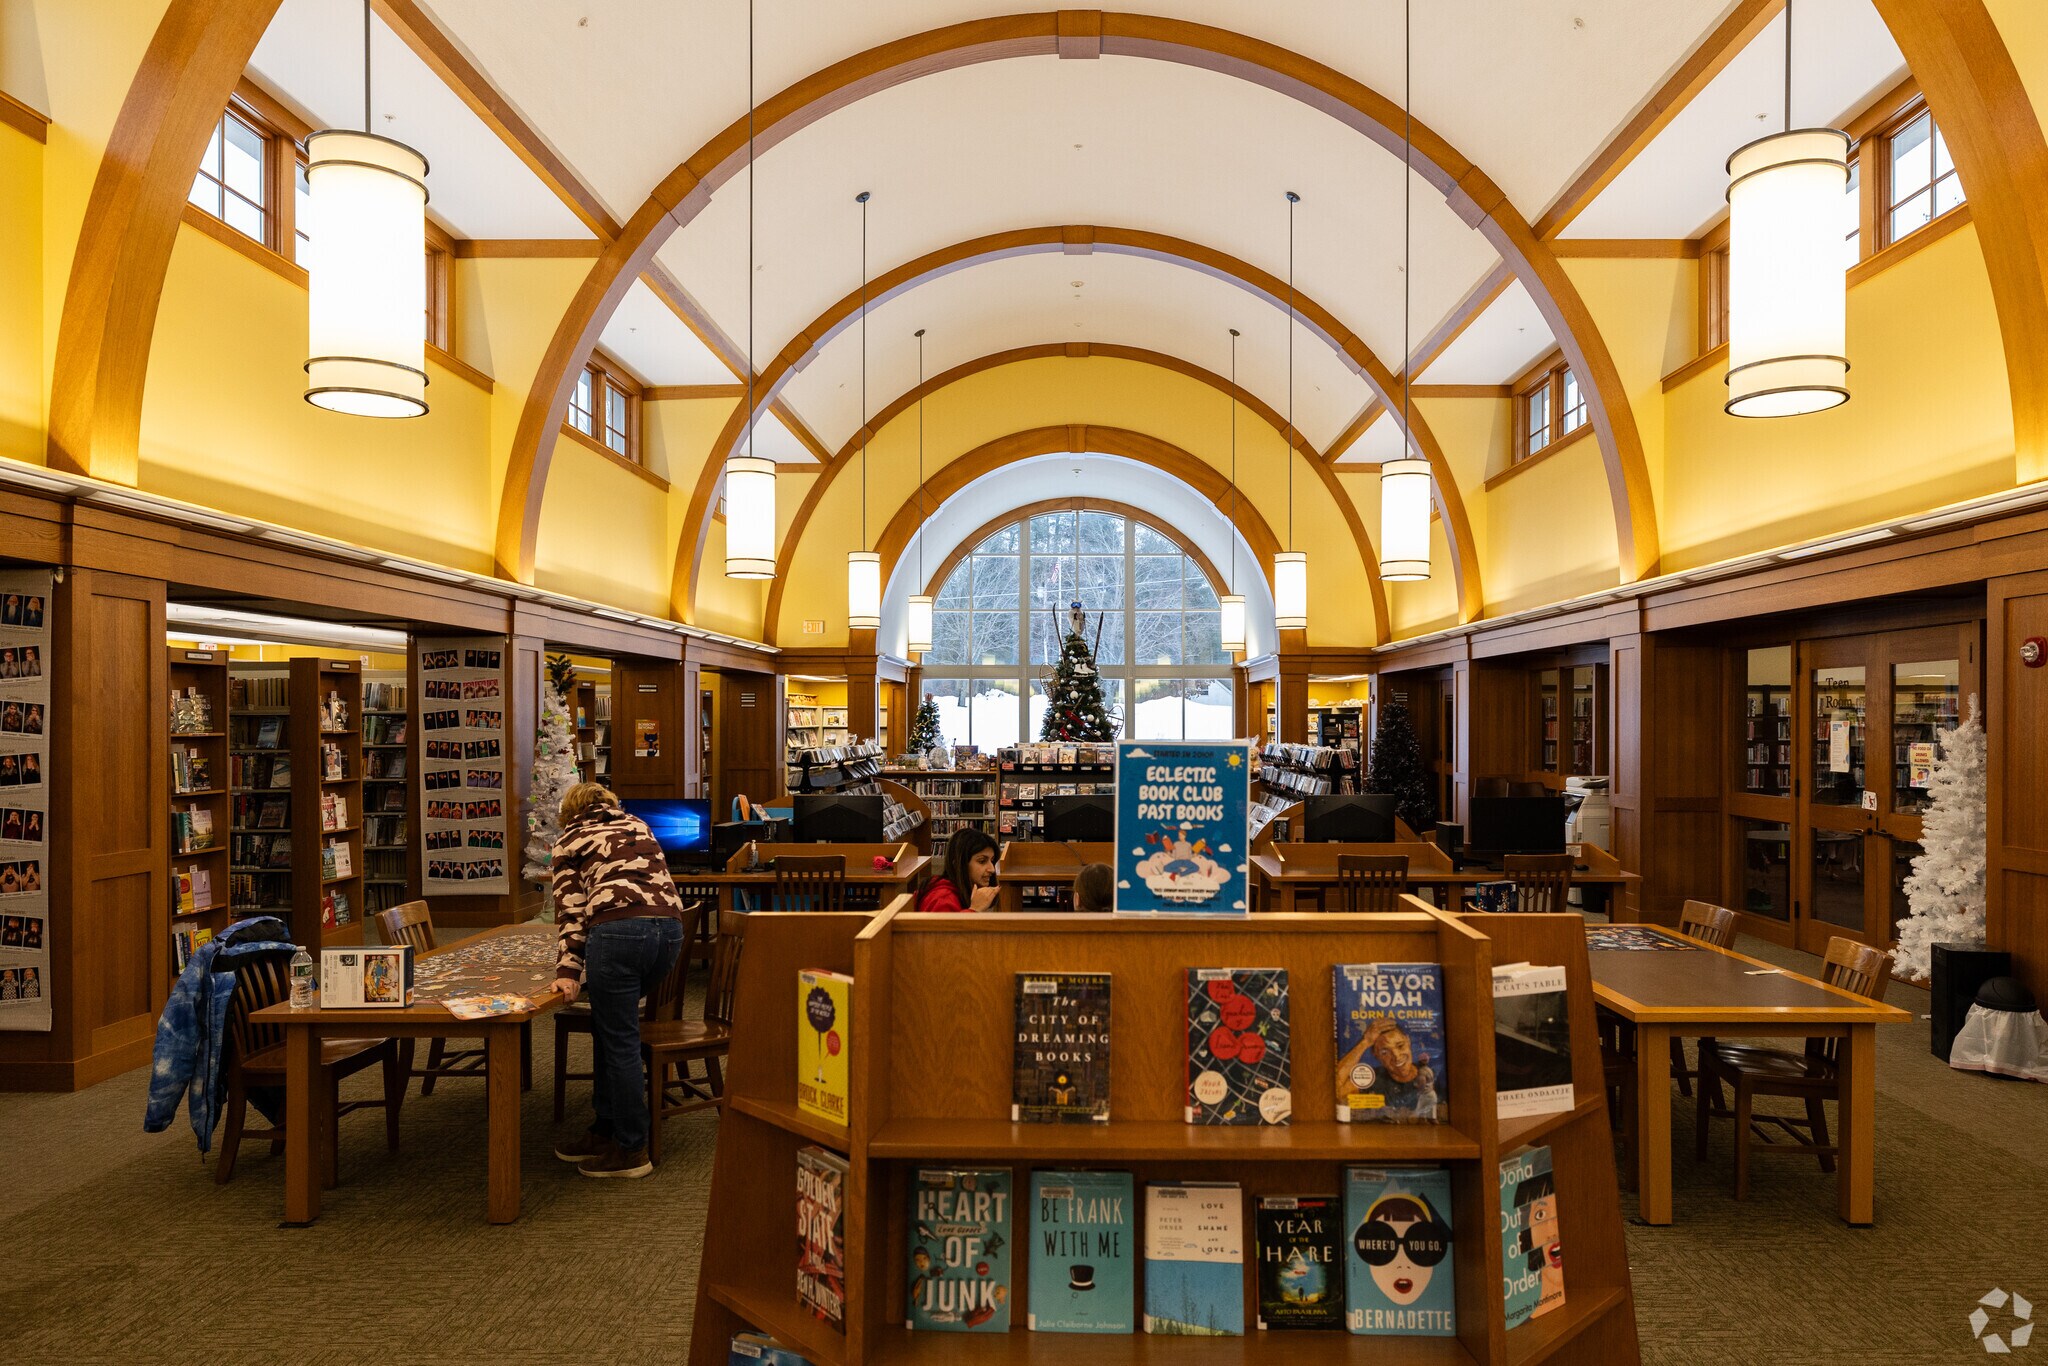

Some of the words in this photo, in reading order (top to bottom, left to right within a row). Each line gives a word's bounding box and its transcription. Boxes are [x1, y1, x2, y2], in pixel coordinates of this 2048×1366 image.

[1825, 677, 1850, 690] Teen
[1825, 695, 1853, 708] Room
[1146, 766, 1217, 783] ECLECTIC
[1138, 784, 1180, 801] BOOK
[1182, 785, 1223, 802] CLUB
[1137, 803, 1174, 820] PAST
[1176, 804, 1224, 821] BOOKS
[1347, 974, 1436, 991] TREVOR
[1503, 982, 1530, 991] CAT'S
[1533, 978, 1563, 989] TABLE
[1053, 996, 1078, 1007] The
[1360, 991, 1423, 1008] NOAH
[1029, 1015, 1069, 1025] CITY
[1078, 1015, 1099, 1025] OF
[1351, 1009, 1385, 1020] BORN
[1387, 1010, 1396, 1020] A
[1397, 1009, 1434, 1020] CRIME
[1018, 1033, 1109, 1044] DREAMING
[1035, 1052, 1092, 1062] BOOKS
[1528, 1087, 1571, 1098] ONDAATJE
[820, 1090, 844, 1115] CLARKE
[796, 1165, 837, 1213] GOLDEN
[918, 1190, 1008, 1223] HEART
[1041, 1198, 1060, 1223] BE
[1068, 1197, 1123, 1225] FRANK
[798, 1198, 836, 1257] STATE
[1274, 1220, 1323, 1234] YEAR
[945, 1236, 981, 1268] OF
[1044, 1230, 1088, 1258] WITH
[1098, 1231, 1120, 1258] ME
[1358, 1239, 1396, 1251] WHERE'D
[1409, 1240, 1427, 1252] YOU
[1266, 1246, 1333, 1262] HARE
[814, 1278, 842, 1320] WINTERS
[922, 1279, 997, 1312] JUNK
[1355, 1308, 1452, 1331] BERNADETTE
